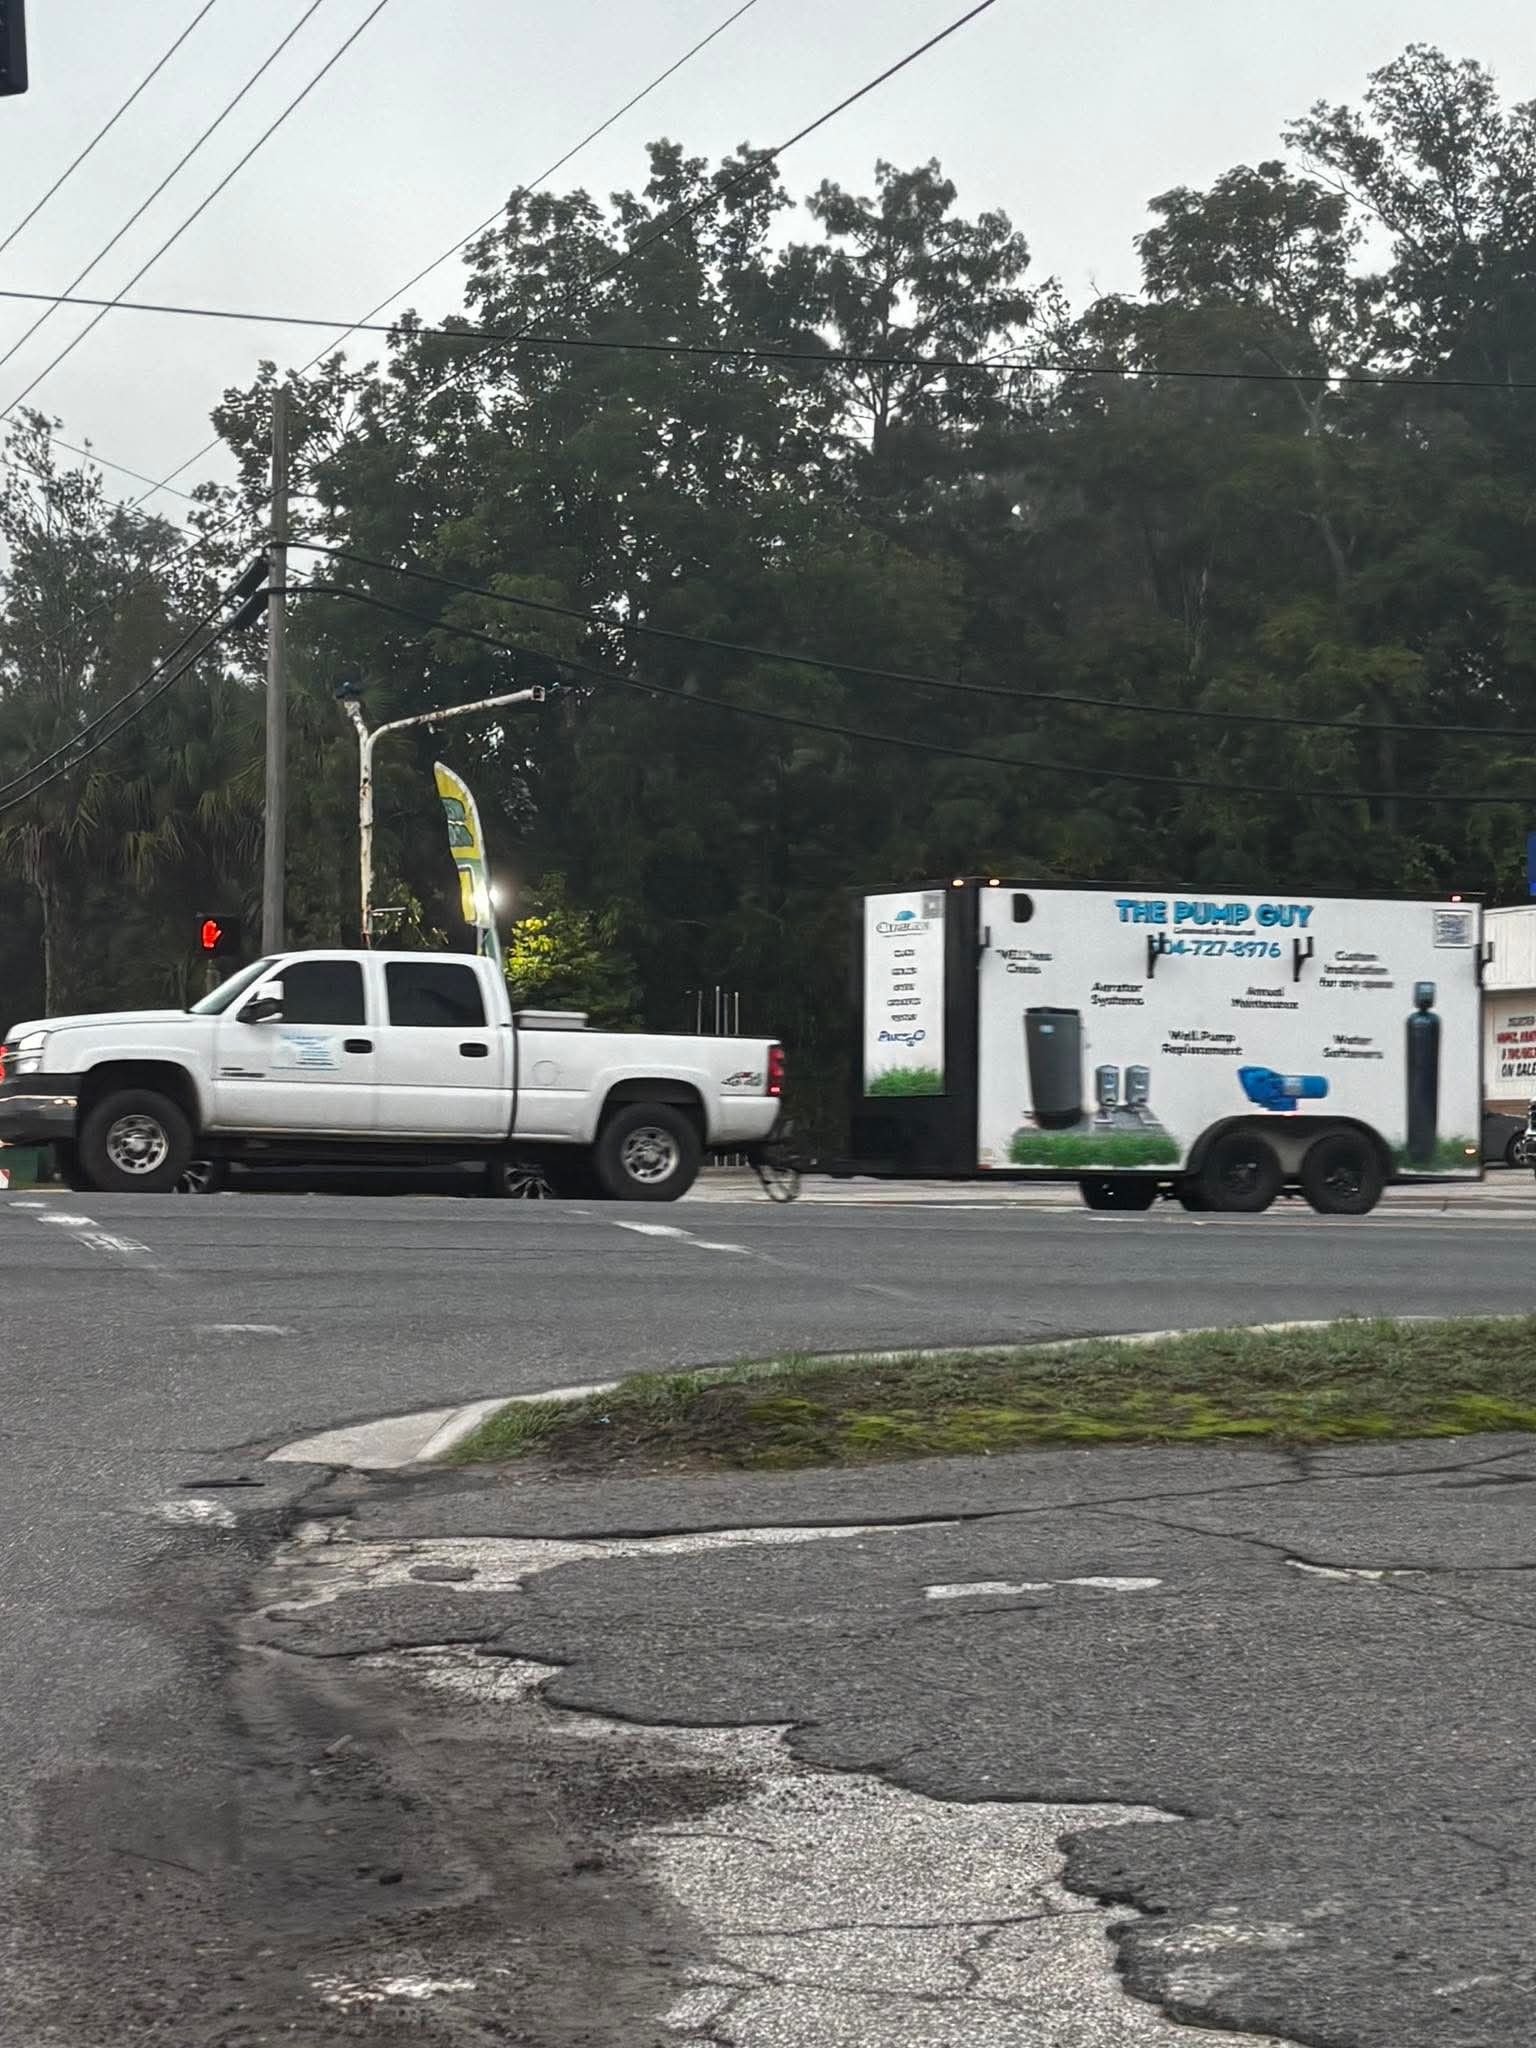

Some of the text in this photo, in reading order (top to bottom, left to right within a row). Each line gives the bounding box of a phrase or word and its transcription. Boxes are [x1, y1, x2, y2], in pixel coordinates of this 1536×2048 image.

[1115, 898, 1315, 928] THE PUMP GUY
